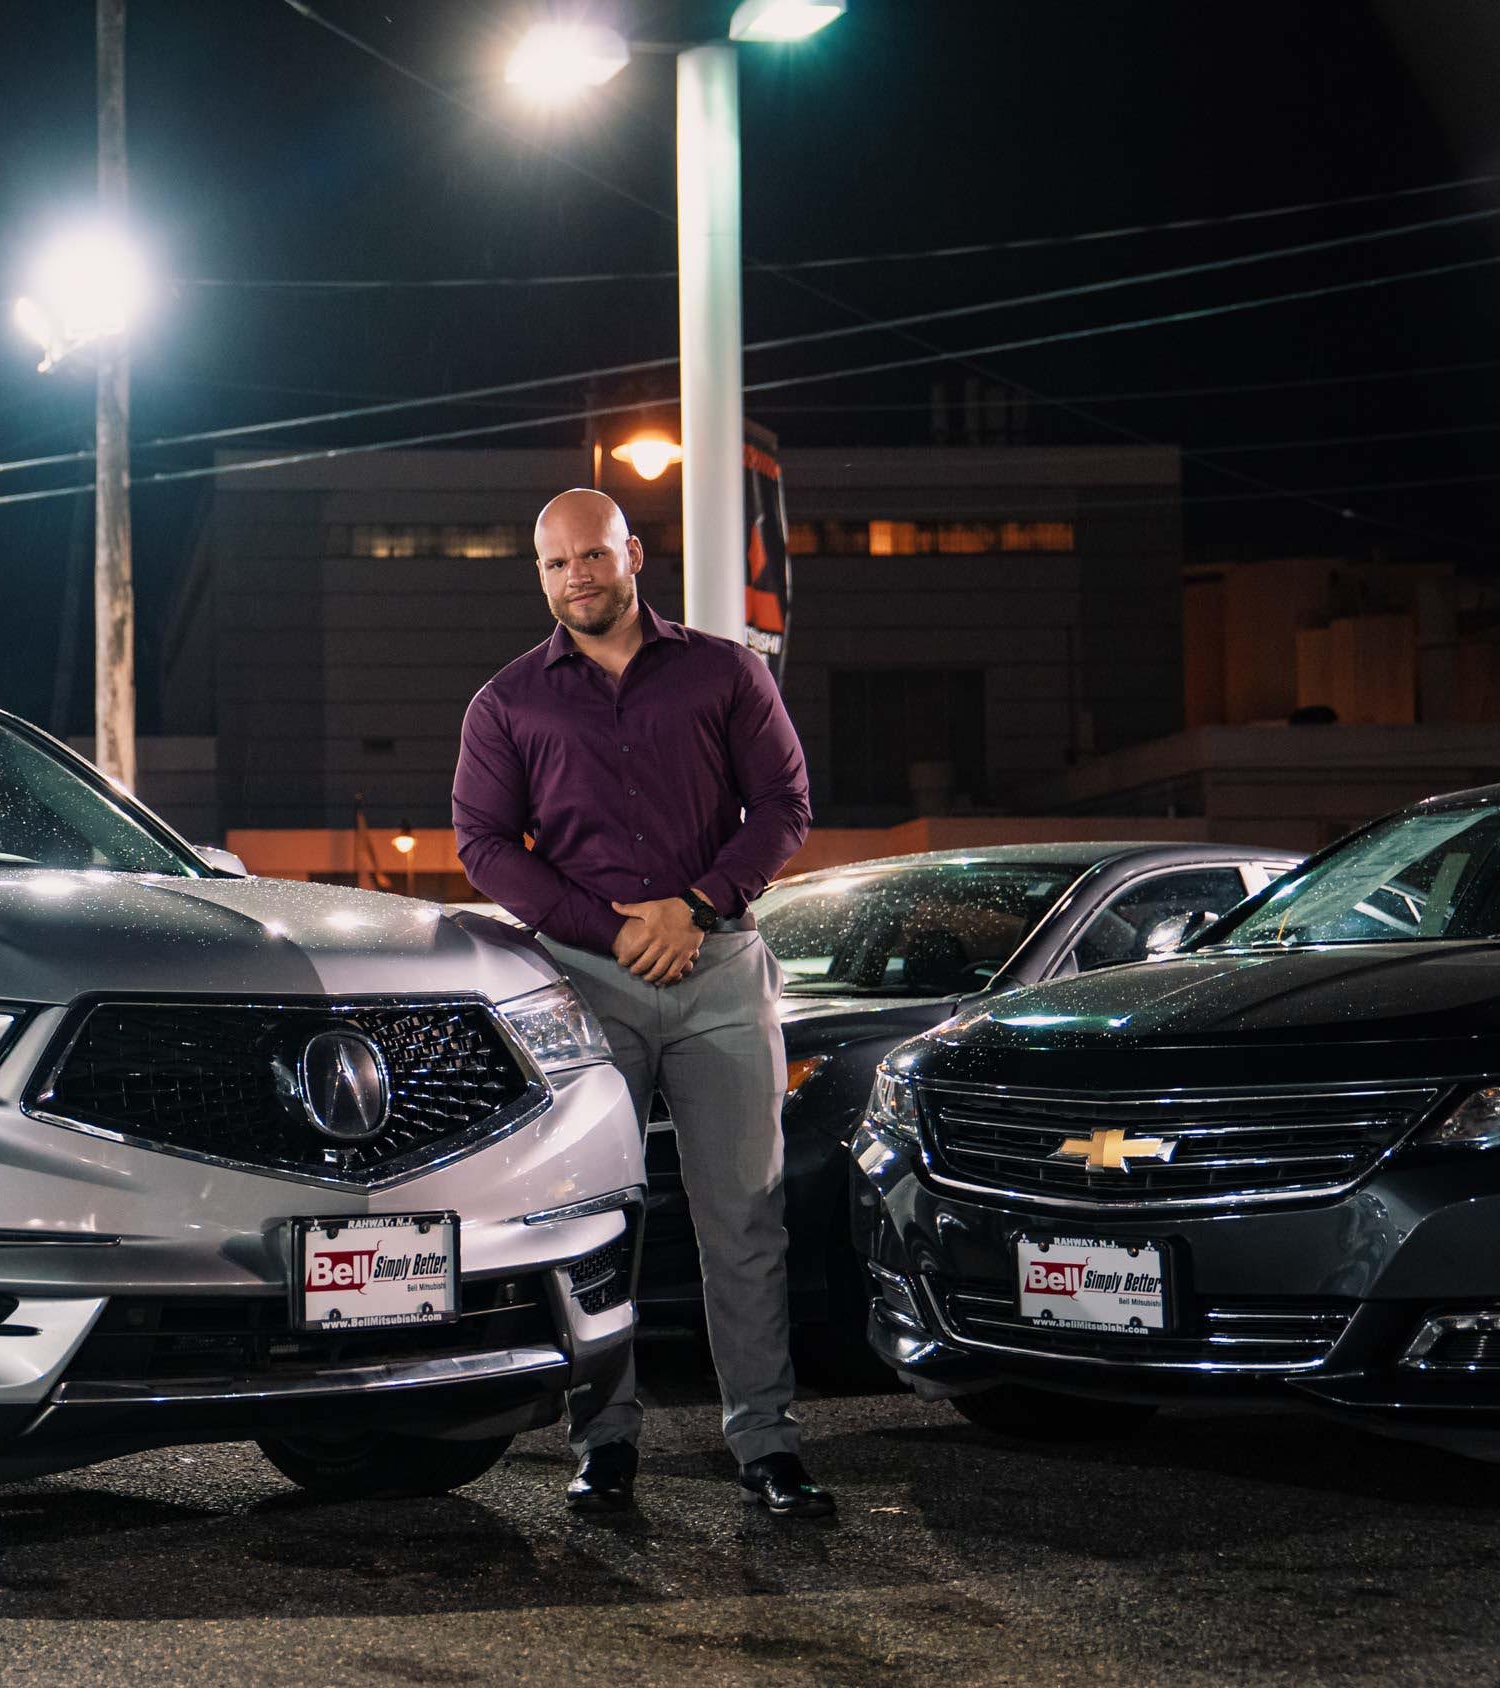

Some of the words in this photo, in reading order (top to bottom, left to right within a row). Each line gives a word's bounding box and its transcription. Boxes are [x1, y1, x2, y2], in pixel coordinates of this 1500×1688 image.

[311, 1255, 369, 1287] Bell
[374, 1255, 411, 1280] Simply
[412, 1253, 448, 1276] Better.
[407, 1284, 418, 1292] Bell
[419, 1282, 447, 1291] Mitsubishi
[1029, 1265, 1080, 1292] Bell
[1084, 1270, 1123, 1293] Simply
[1118, 1297, 1130, 1305] Bell
[321, 1313, 442, 1330] www.BellMitsubishi.com
[1032, 1318, 1149, 1335] www.BellMitsubishi.com
